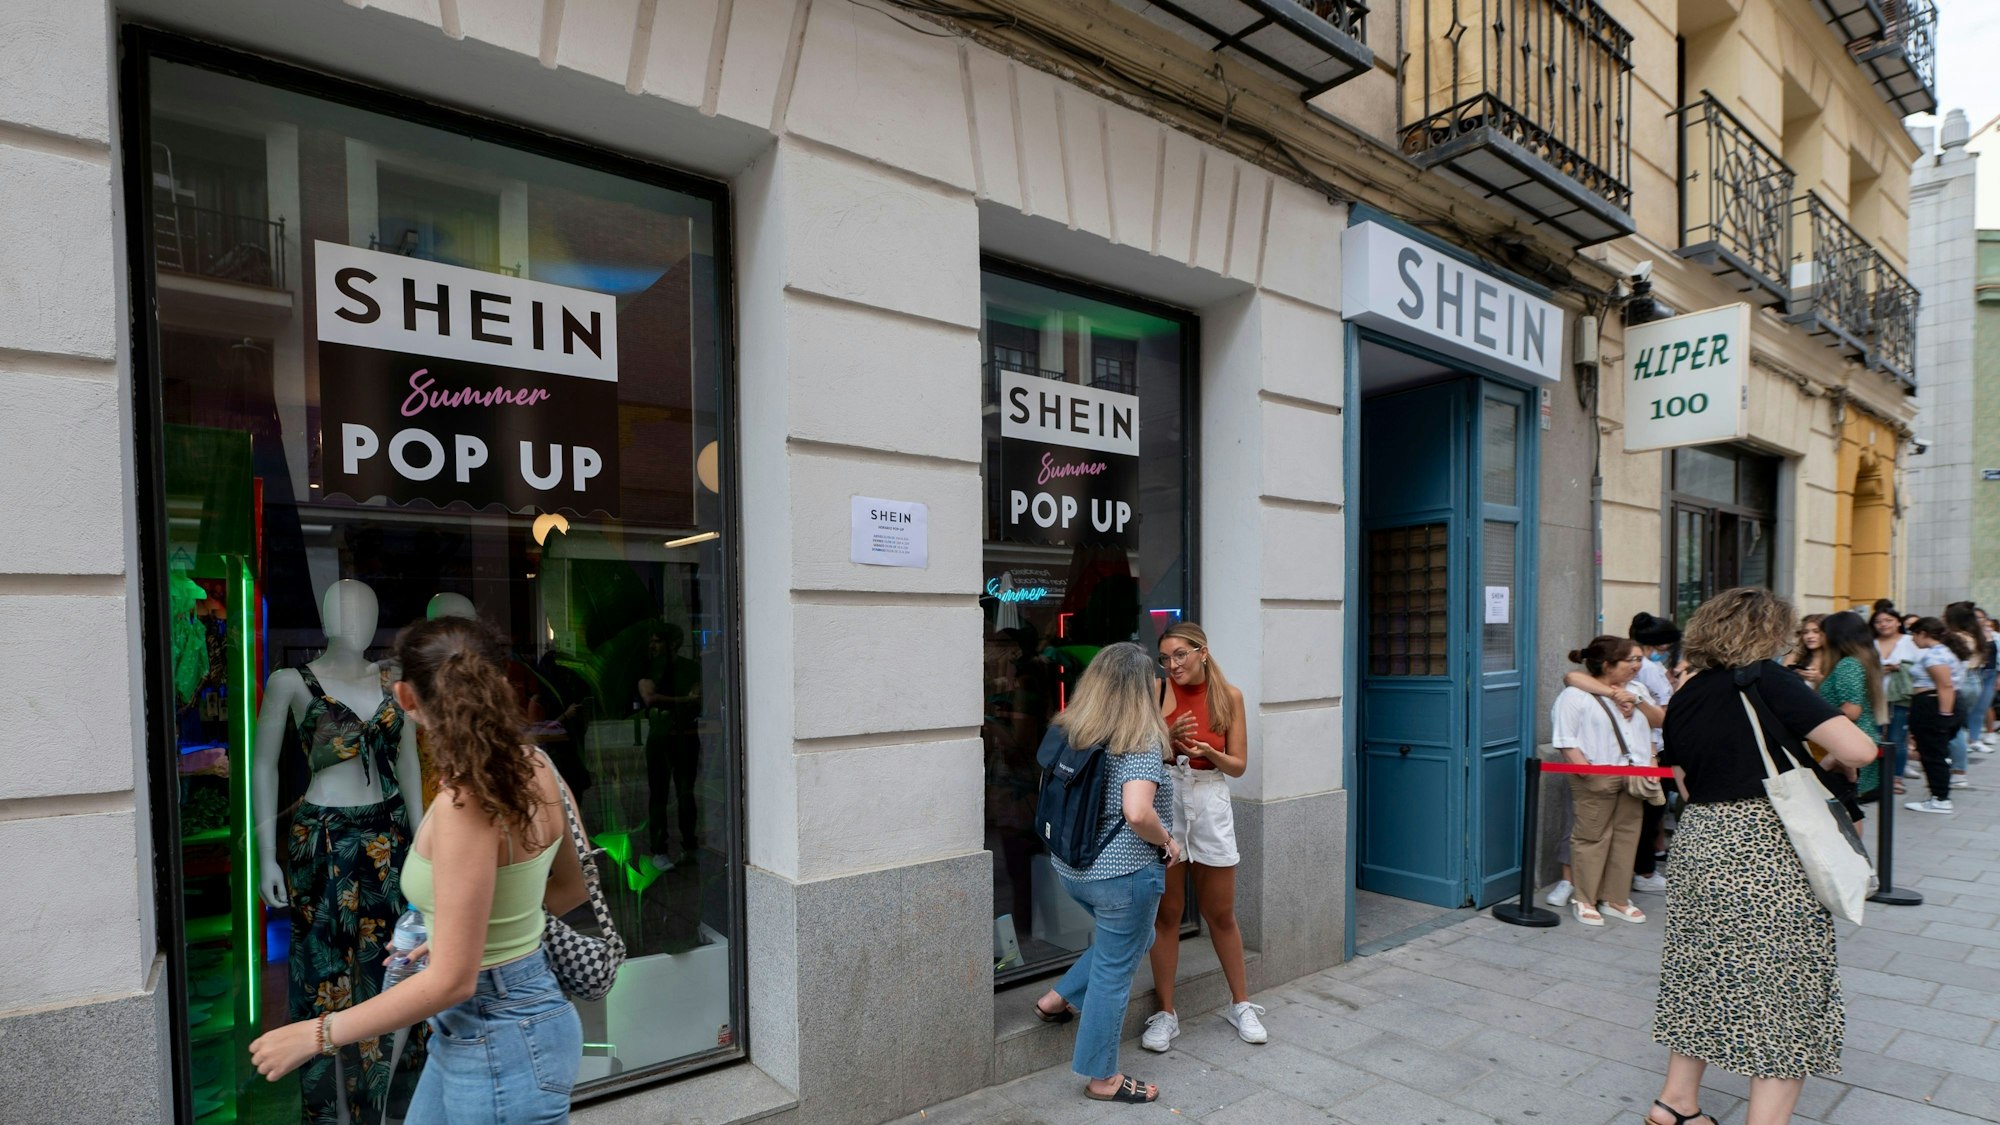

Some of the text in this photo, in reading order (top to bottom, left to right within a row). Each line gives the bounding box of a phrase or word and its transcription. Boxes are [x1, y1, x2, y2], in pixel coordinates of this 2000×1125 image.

[334, 267, 603, 360] SHEIN
[1396, 246, 1546, 368] SHEIN
[1633, 332, 1731, 381] HIPER
[400, 368, 551, 417] Summer
[1009, 386, 1132, 441] SHEIN
[1650, 392, 1709, 420] 100
[341, 422, 603, 493] POP UP
[1036, 451, 1108, 486] Summer
[871, 509, 911, 523] SHEIN
[1010, 489, 1132, 533] POP UP
